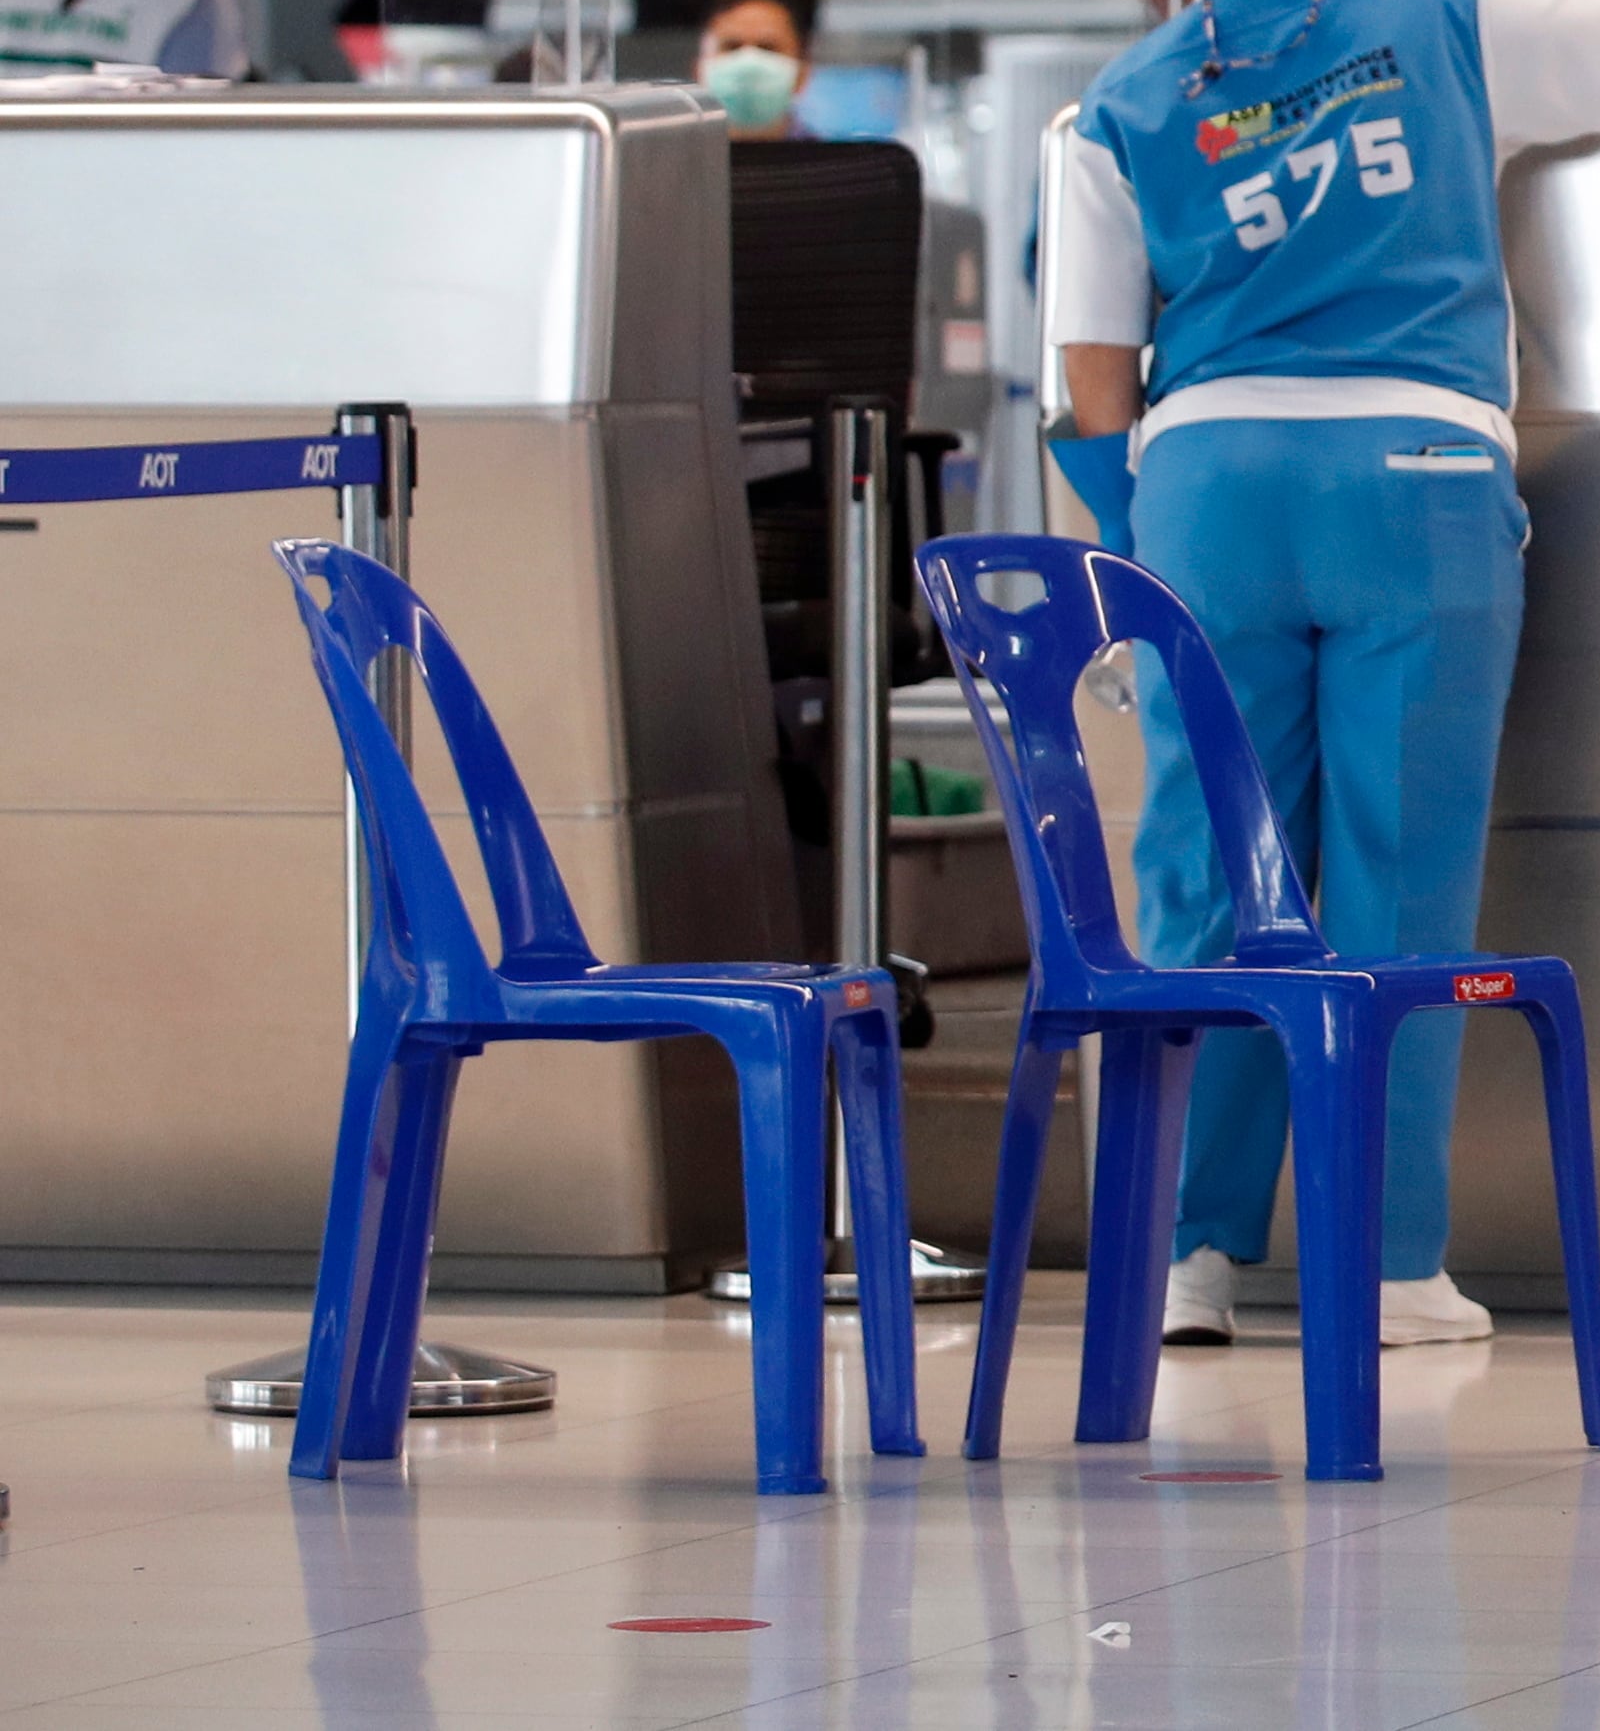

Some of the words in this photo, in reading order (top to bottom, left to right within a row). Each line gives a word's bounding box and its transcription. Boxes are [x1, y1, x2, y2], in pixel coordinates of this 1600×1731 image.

[1272, 46, 1394, 109] MAINTENANCE
[1277, 61, 1399, 126] SERVICES
[1222, 117, 1414, 251] 575
[138, 452, 179, 489] AOT
[302, 444, 340, 480] AOT
[1473, 977, 1506, 996] Super
